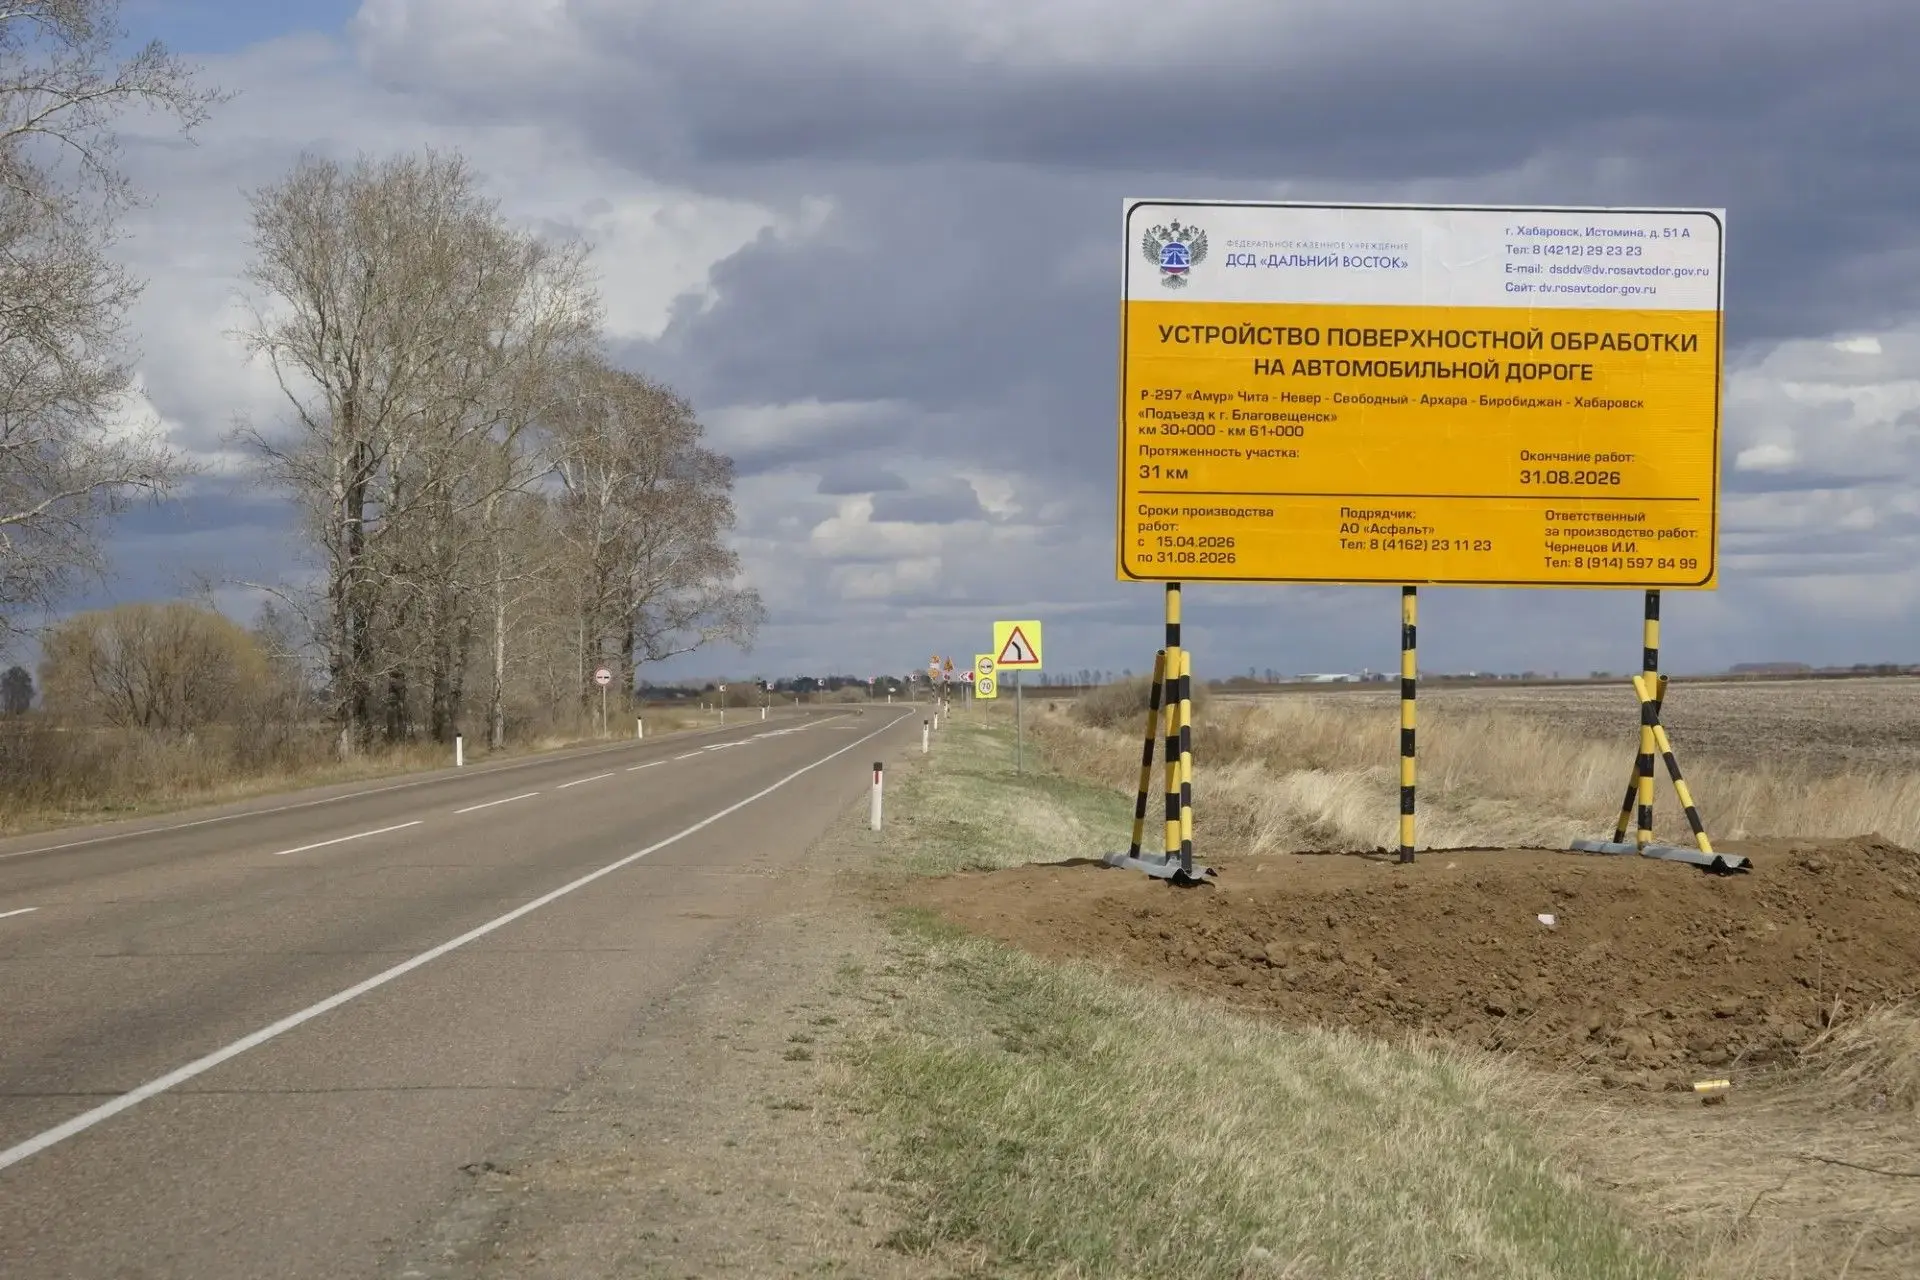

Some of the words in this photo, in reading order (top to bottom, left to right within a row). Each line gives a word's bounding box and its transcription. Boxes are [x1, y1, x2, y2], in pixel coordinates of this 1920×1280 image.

[1506, 228, 1514, 236] г.
[1517, 226, 1582, 238] Хабаровск,
[1586, 227, 1646, 238] Истомина,
[1650, 230, 1660, 239] д.
[1664, 228, 1678, 237] 51
[1682, 228, 1690, 238] А
[1226, 240, 1294, 248] ФЕДЕРАЛЬНОЕ
[1296, 241, 1346, 250] КАЗЕННОЕ
[1506, 244, 1530, 254] Тел:
[1532, 245, 1540, 254] 8
[1544, 245, 1584, 256] (4212)
[1587, 246, 1602, 256] 29
[1606, 246, 1622, 256] 23
[1626, 246, 1642, 256] 23
[1226, 254, 1256, 267] ДСД
[1260, 252, 1338, 268] «ДАЛЬНИЙ
[1343, 256, 1408, 268] ВОСТОК»
[1506, 264, 1543, 274] E-mail:
[1549, 265, 1709, 278] dsddv@dv.rosavtodor.gov.ru
[1506, 282, 1536, 292] Сайт:
[1539, 283, 1656, 296] dv.rosavtodor.gov.ru
[1158, 322, 1320, 346] УСТРОЙСТВО
[1328, 326, 1544, 350] ПОВЕРХНОСТНОЙ
[1551, 331, 1698, 352] ОБРАБОТКИ
[1254, 358, 1284, 376] НА
[1292, 359, 1500, 380] АВТОМОБИЛЬНОЙ
[1506, 363, 1593, 383] ДОРОГЕ
[1141, 390, 1182, 401] Р-297
[1186, 390, 1234, 404] «Амур»
[1238, 392, 1268, 403] Чита
[1281, 392, 1321, 405] Невер
[1334, 393, 1408, 406] Свободный
[1420, 394, 1468, 406] Архара
[1480, 395, 1562, 408] Биробиджан
[1574, 396, 1644, 410] Хабаровск
[1138, 408, 1204, 422] «Подъезд
[1208, 412, 1216, 420] к
[1220, 412, 1228, 420] г.
[1232, 410, 1337, 424] Благовещенск»
[1139, 426, 1156, 436] км
[1160, 424, 1215, 436] 30+000
[1228, 428, 1245, 436] км
[1250, 425, 1304, 437] 61+000
[1139, 446, 1241, 458] Протяженность
[1246, 448, 1300, 460] участка:
[1520, 450, 1590, 462] Окончание
[1594, 451, 1634, 464] работ:
[1140, 465, 1160, 478] 31
[1166, 468, 1188, 479] км
[1520, 470, 1620, 485] 31.08.2026
[1138, 505, 1178, 518] Сроки
[1182, 507, 1274, 518] производства
[1340, 507, 1416, 520] Подрядчик:
[1545, 510, 1646, 522] Ответственный
[1138, 521, 1178, 533] работ:
[1340, 524, 1360, 534] АО
[1364, 524, 1434, 536] «Асфальт»
[1545, 528, 1560, 537] за
[1564, 528, 1654, 539] производство
[1658, 528, 1698, 540] работ:
[1156, 536, 1234, 548] 15.04.2026
[1340, 539, 1366, 550] Тел:
[1370, 539, 1378, 550] 8
[1382, 540, 1428, 552] (4162)
[1432, 540, 1451, 551] 23
[1456, 540, 1468, 551] 11
[1474, 540, 1492, 552] 23
[1545, 542, 1608, 554] Чернецов
[1612, 542, 1638, 554] И.И.
[1138, 554, 1152, 564] по
[1157, 552, 1236, 564] 31.08.2026
[1545, 556, 1571, 568] Тел:
[1574, 557, 1584, 568] 8
[1588, 558, 1622, 570] (914)
[1627, 558, 1654, 569] 597
[1658, 558, 1675, 569] 84
[1680, 558, 1697, 570] 99
